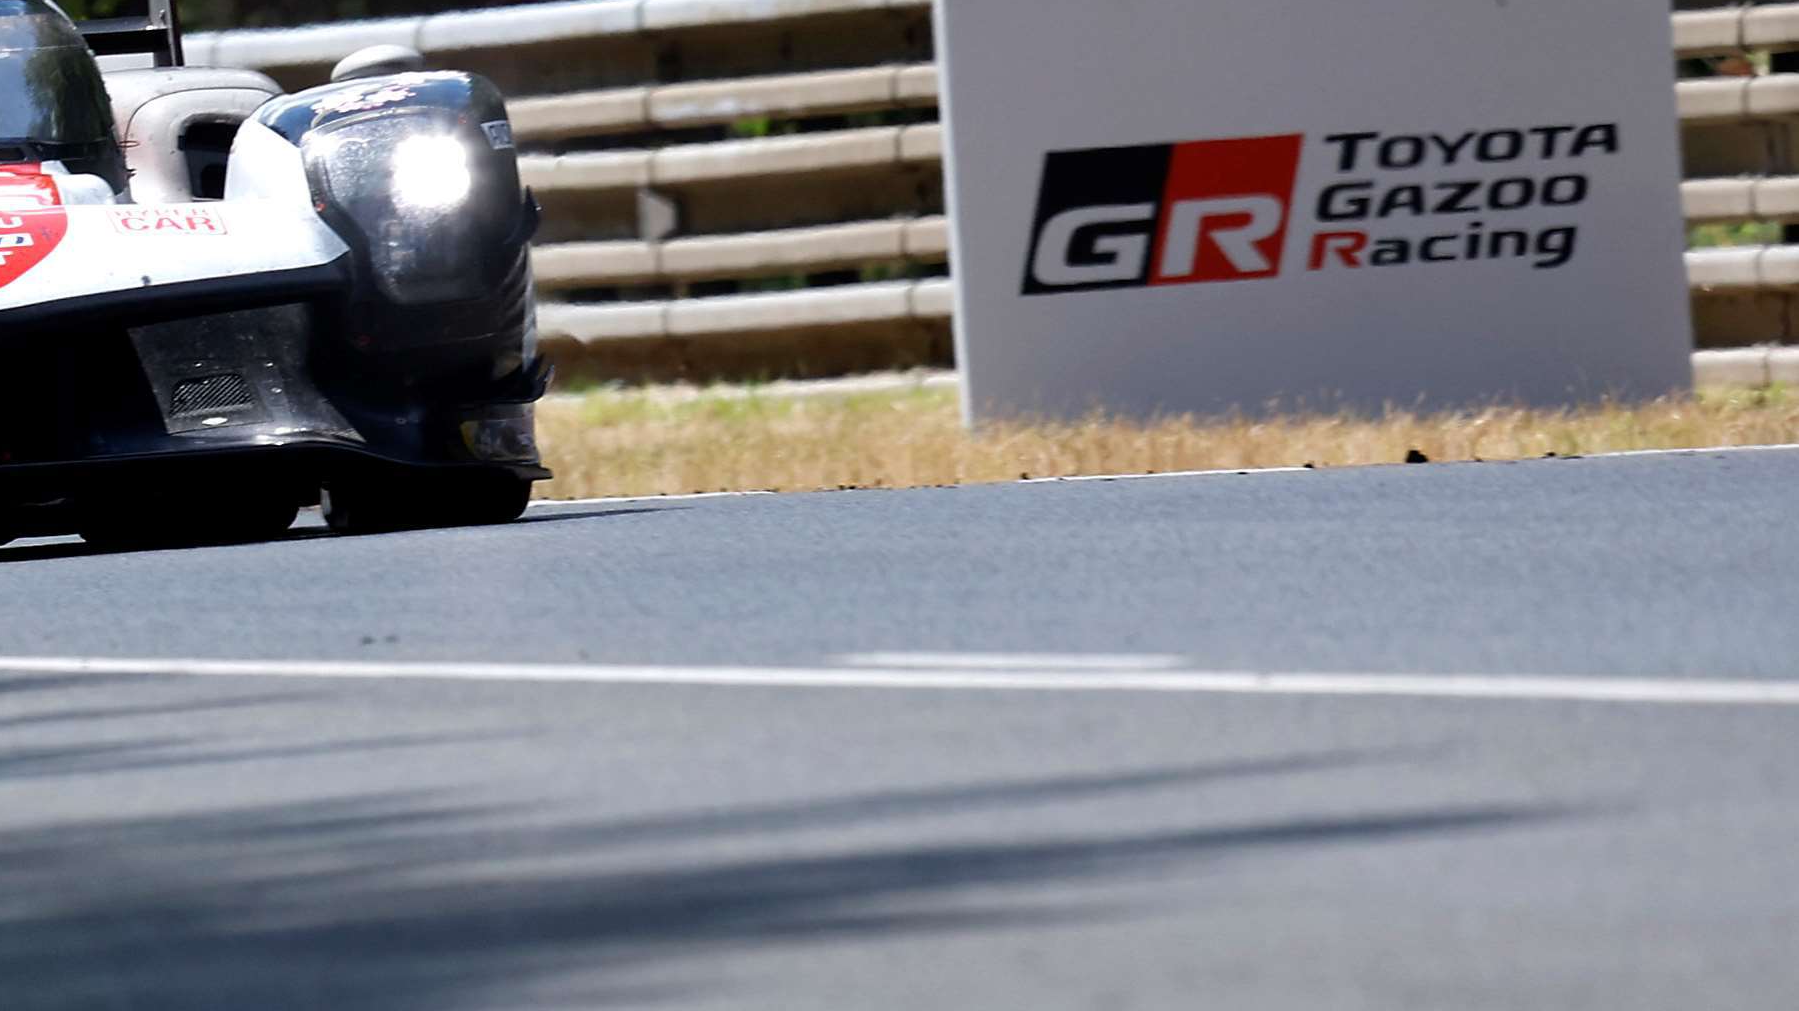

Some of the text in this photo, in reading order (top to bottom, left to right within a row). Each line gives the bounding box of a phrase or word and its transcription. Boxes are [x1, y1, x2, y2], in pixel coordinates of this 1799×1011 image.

[1323, 123, 1619, 172] TOYOTA
[1315, 174, 1589, 223] GAZOO
[120, 216, 216, 231] CAR
[1031, 193, 1283, 286] GR
[1307, 222, 1577, 270] Racing
